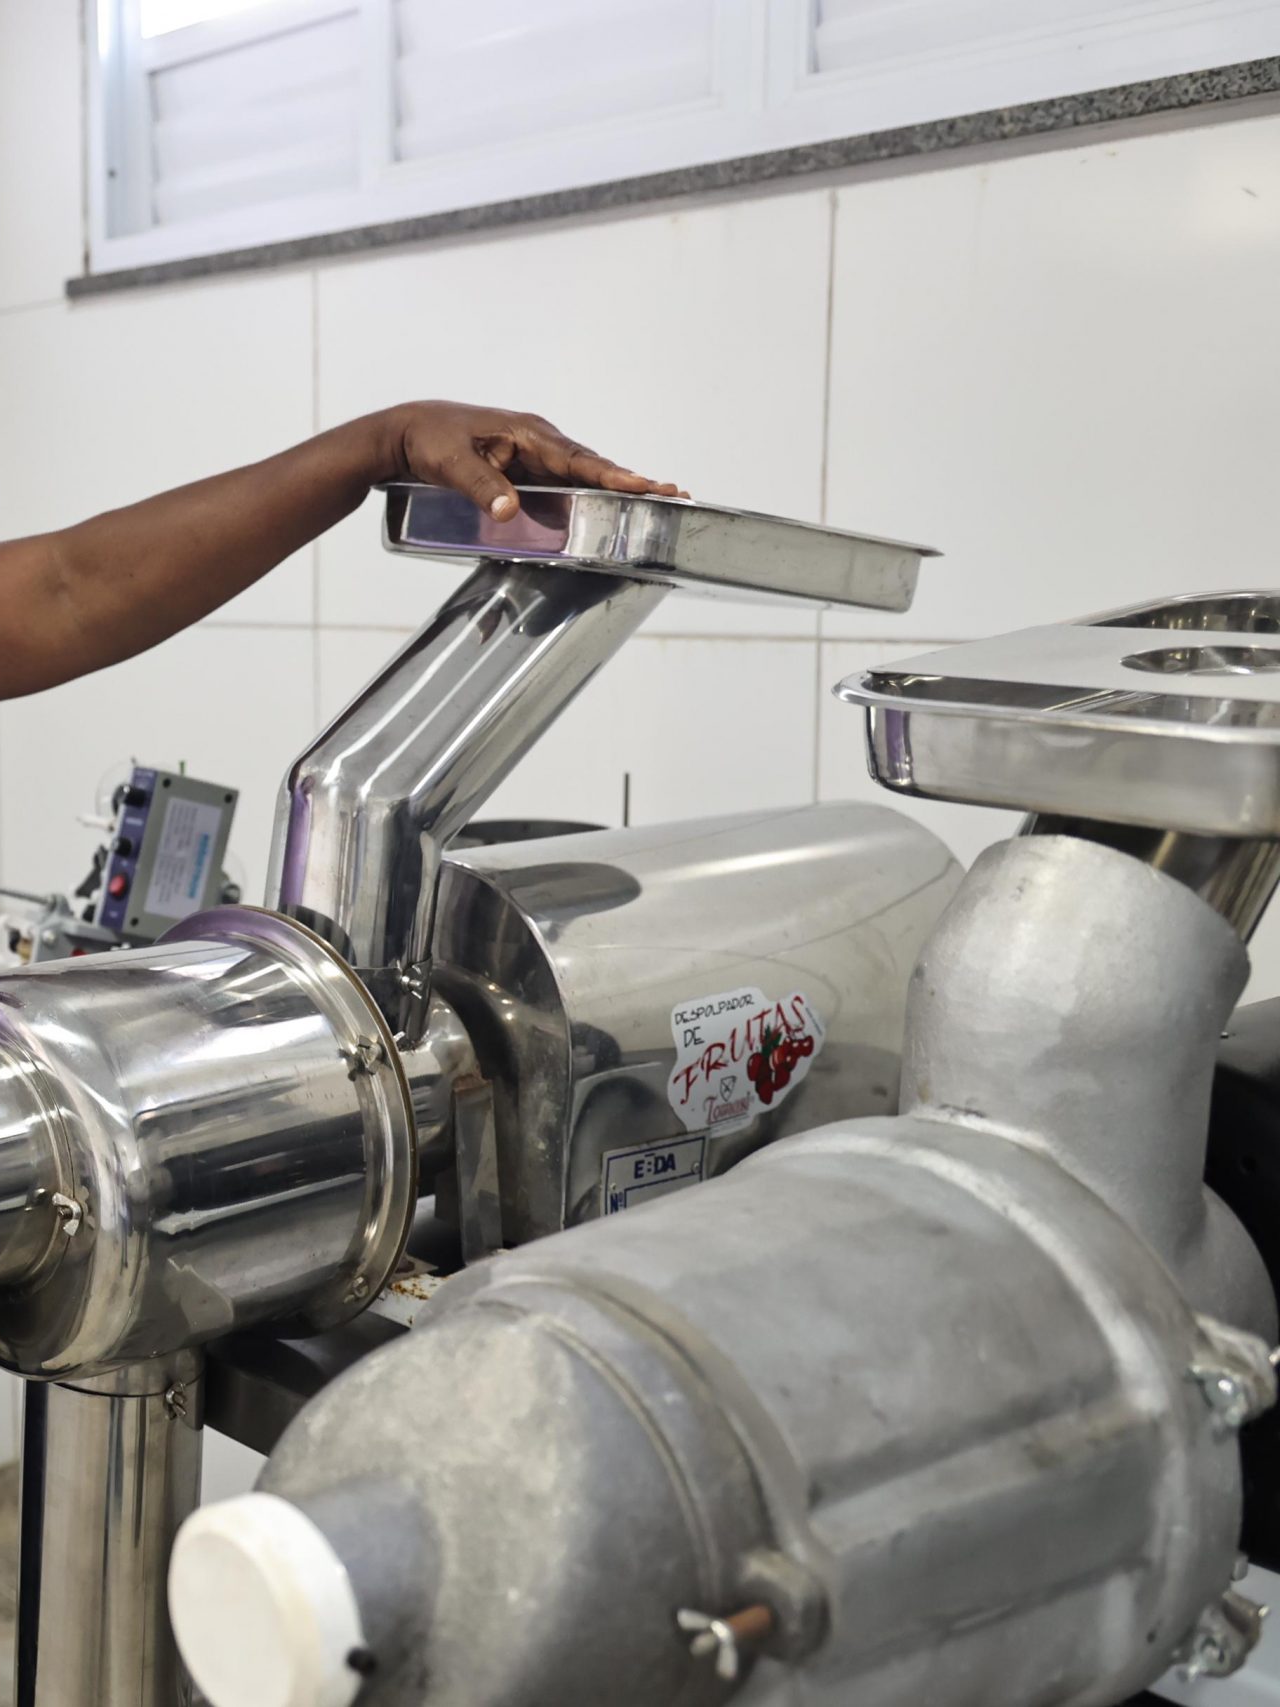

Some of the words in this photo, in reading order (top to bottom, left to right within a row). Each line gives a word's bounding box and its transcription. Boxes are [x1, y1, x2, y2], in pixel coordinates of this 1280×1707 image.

[674, 994, 755, 1025] DESPOLPADOR
[673, 995, 806, 1105] FRUTAS
[683, 1026, 705, 1048] DE
